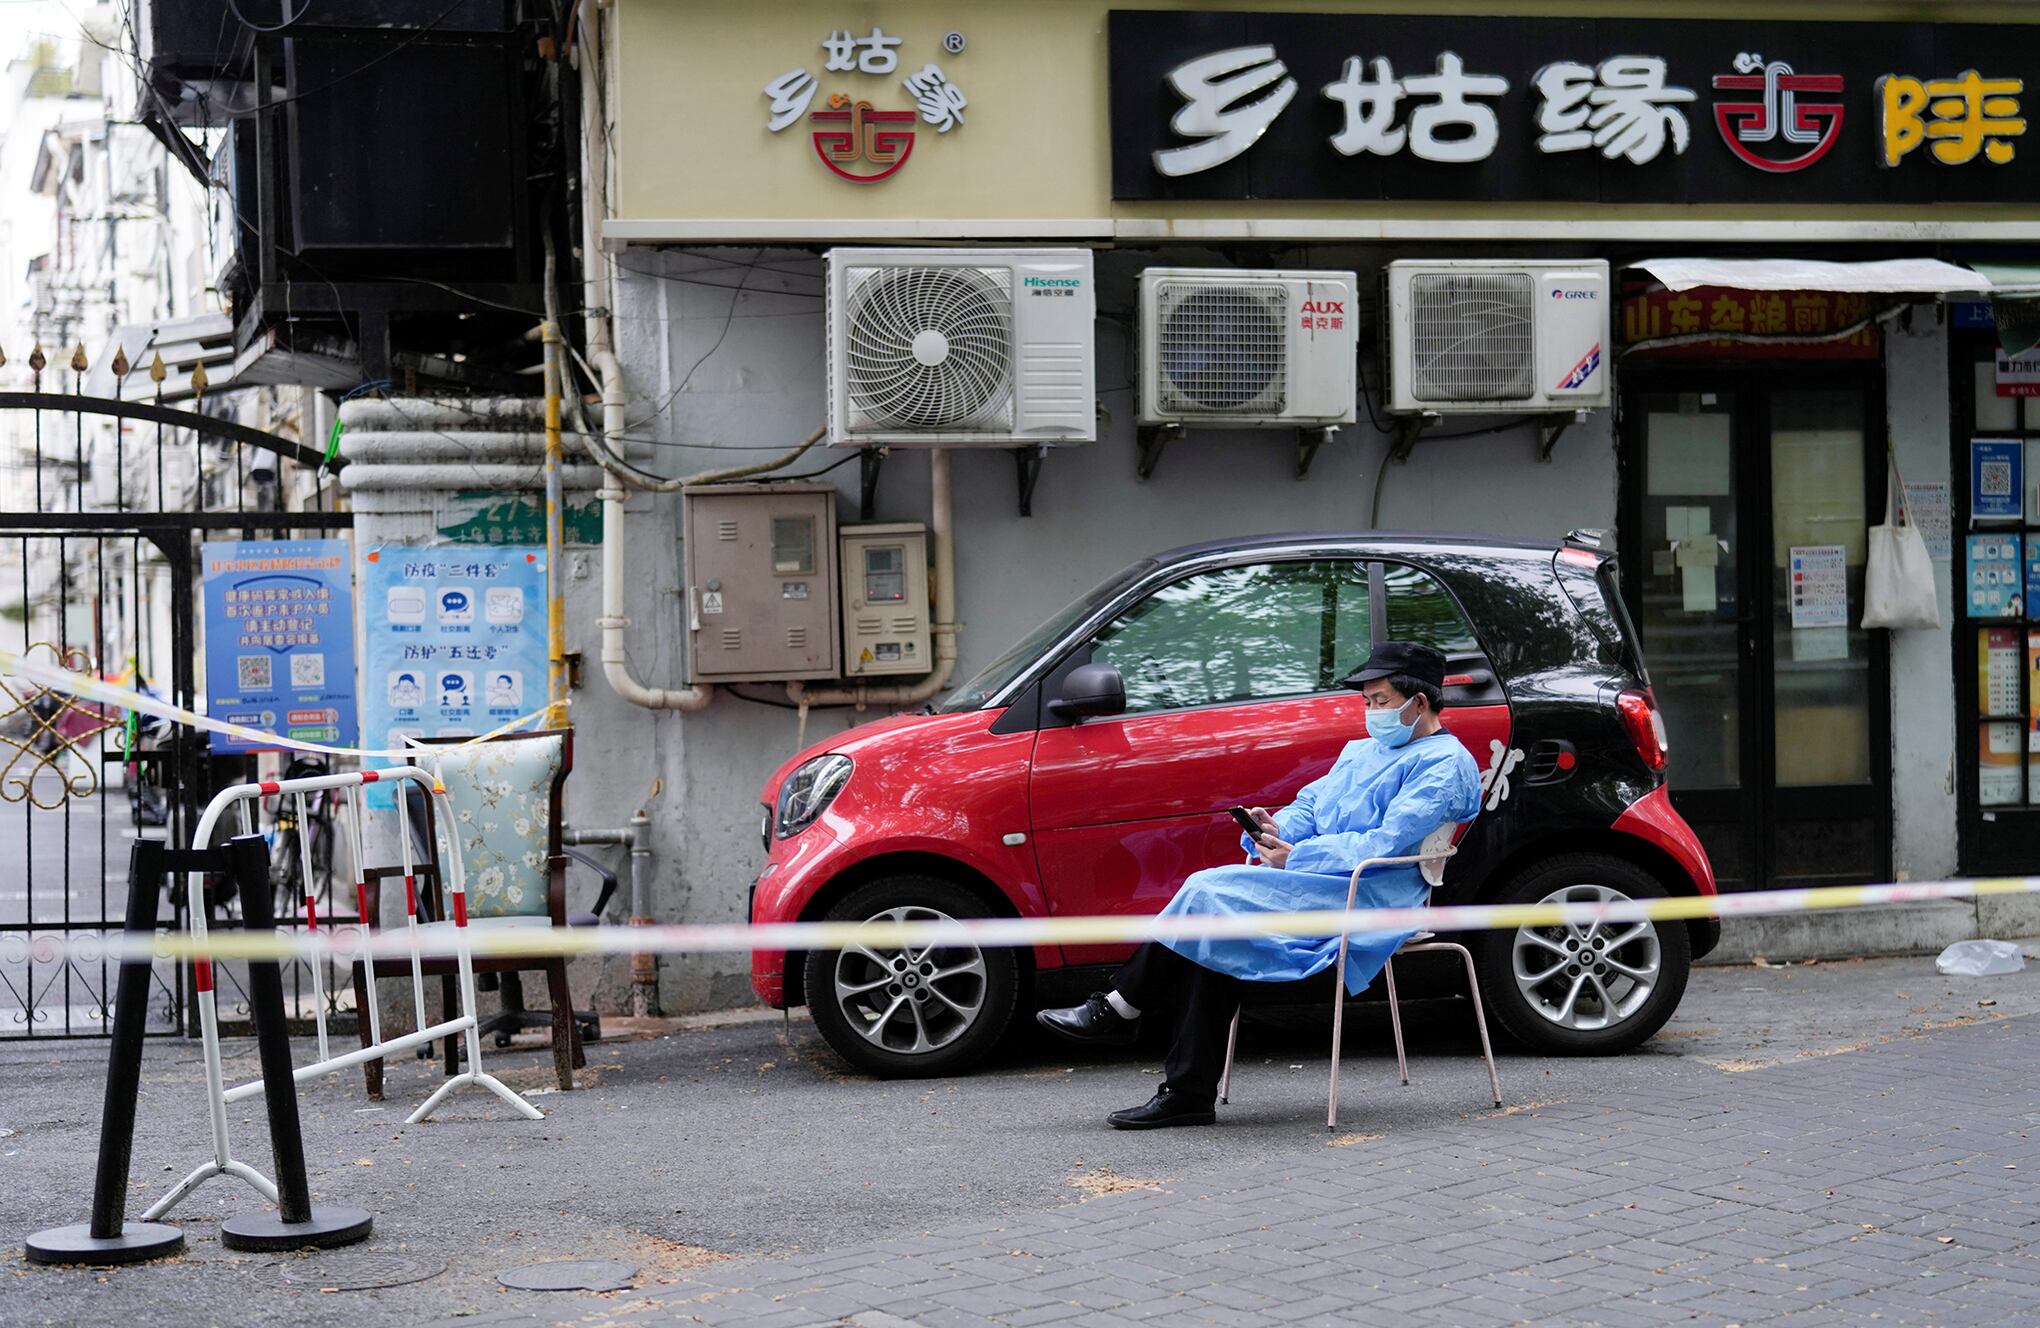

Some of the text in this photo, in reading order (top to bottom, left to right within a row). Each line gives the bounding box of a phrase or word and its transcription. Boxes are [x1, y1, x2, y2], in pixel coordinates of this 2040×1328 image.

[763, 26, 968, 134] 乡姑缘
[1153, 43, 1698, 178] 乡姑缘
[1024, 277, 1080, 287] Hisense
[1564, 290, 1598, 300] GREE
[1301, 301, 1344, 314] AUX
[1301, 316, 1343, 330] 奥克斯
[470, 526, 581, 543] 乌鲁木齐路
